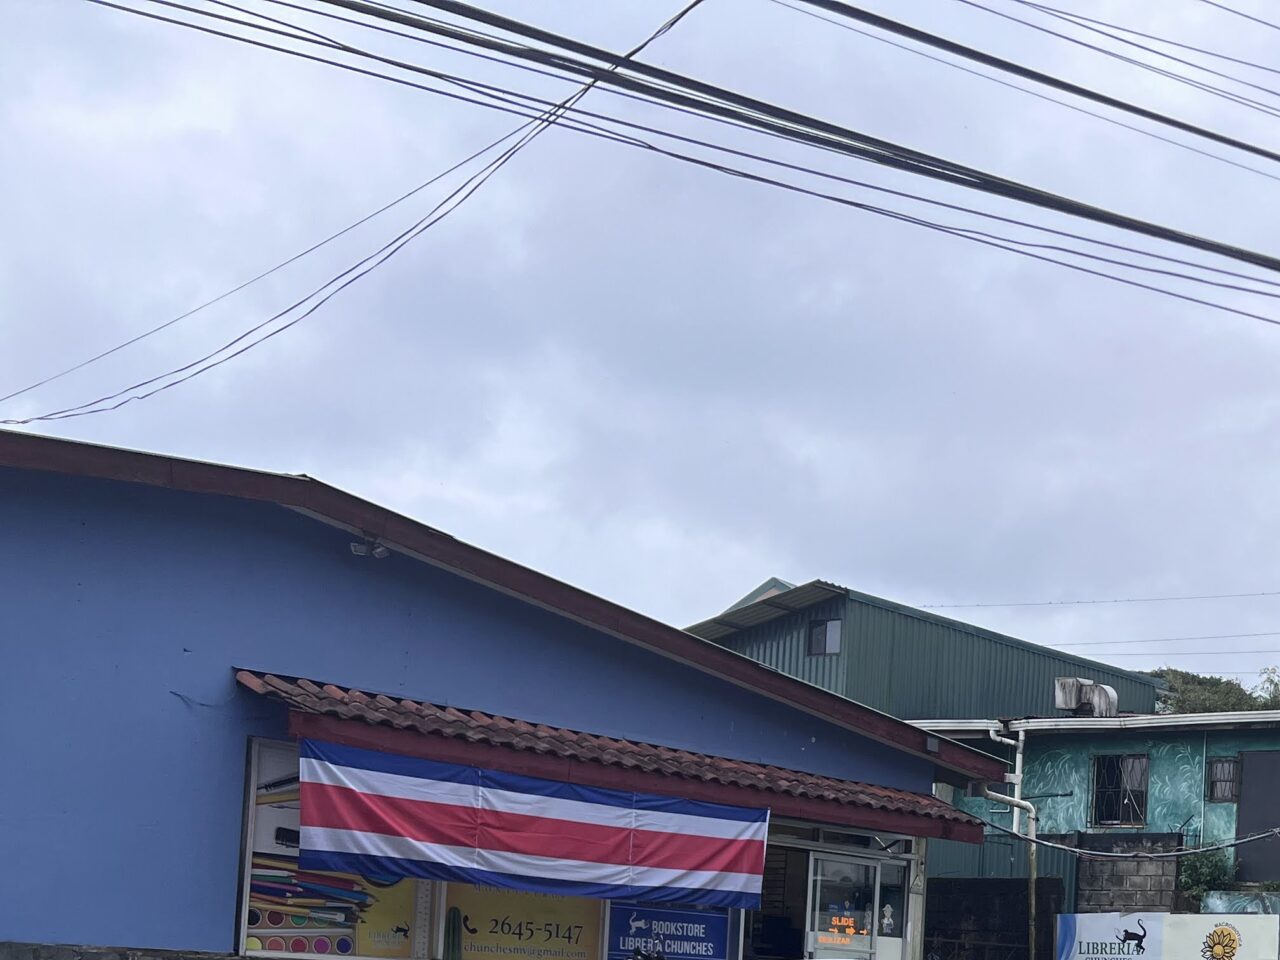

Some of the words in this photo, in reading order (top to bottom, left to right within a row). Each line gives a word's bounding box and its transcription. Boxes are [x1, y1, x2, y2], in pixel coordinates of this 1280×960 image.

[488, 916, 584, 945] 2645-5147
[652, 920, 706, 938] BOOKSTORE
[831, 916, 855, 926] SLIDE
[463, 941, 586, 960] chunchesmv@gmail.com
[619, 936, 663, 952] LIBRERA
[665, 940, 714, 956] CHUNCHES
